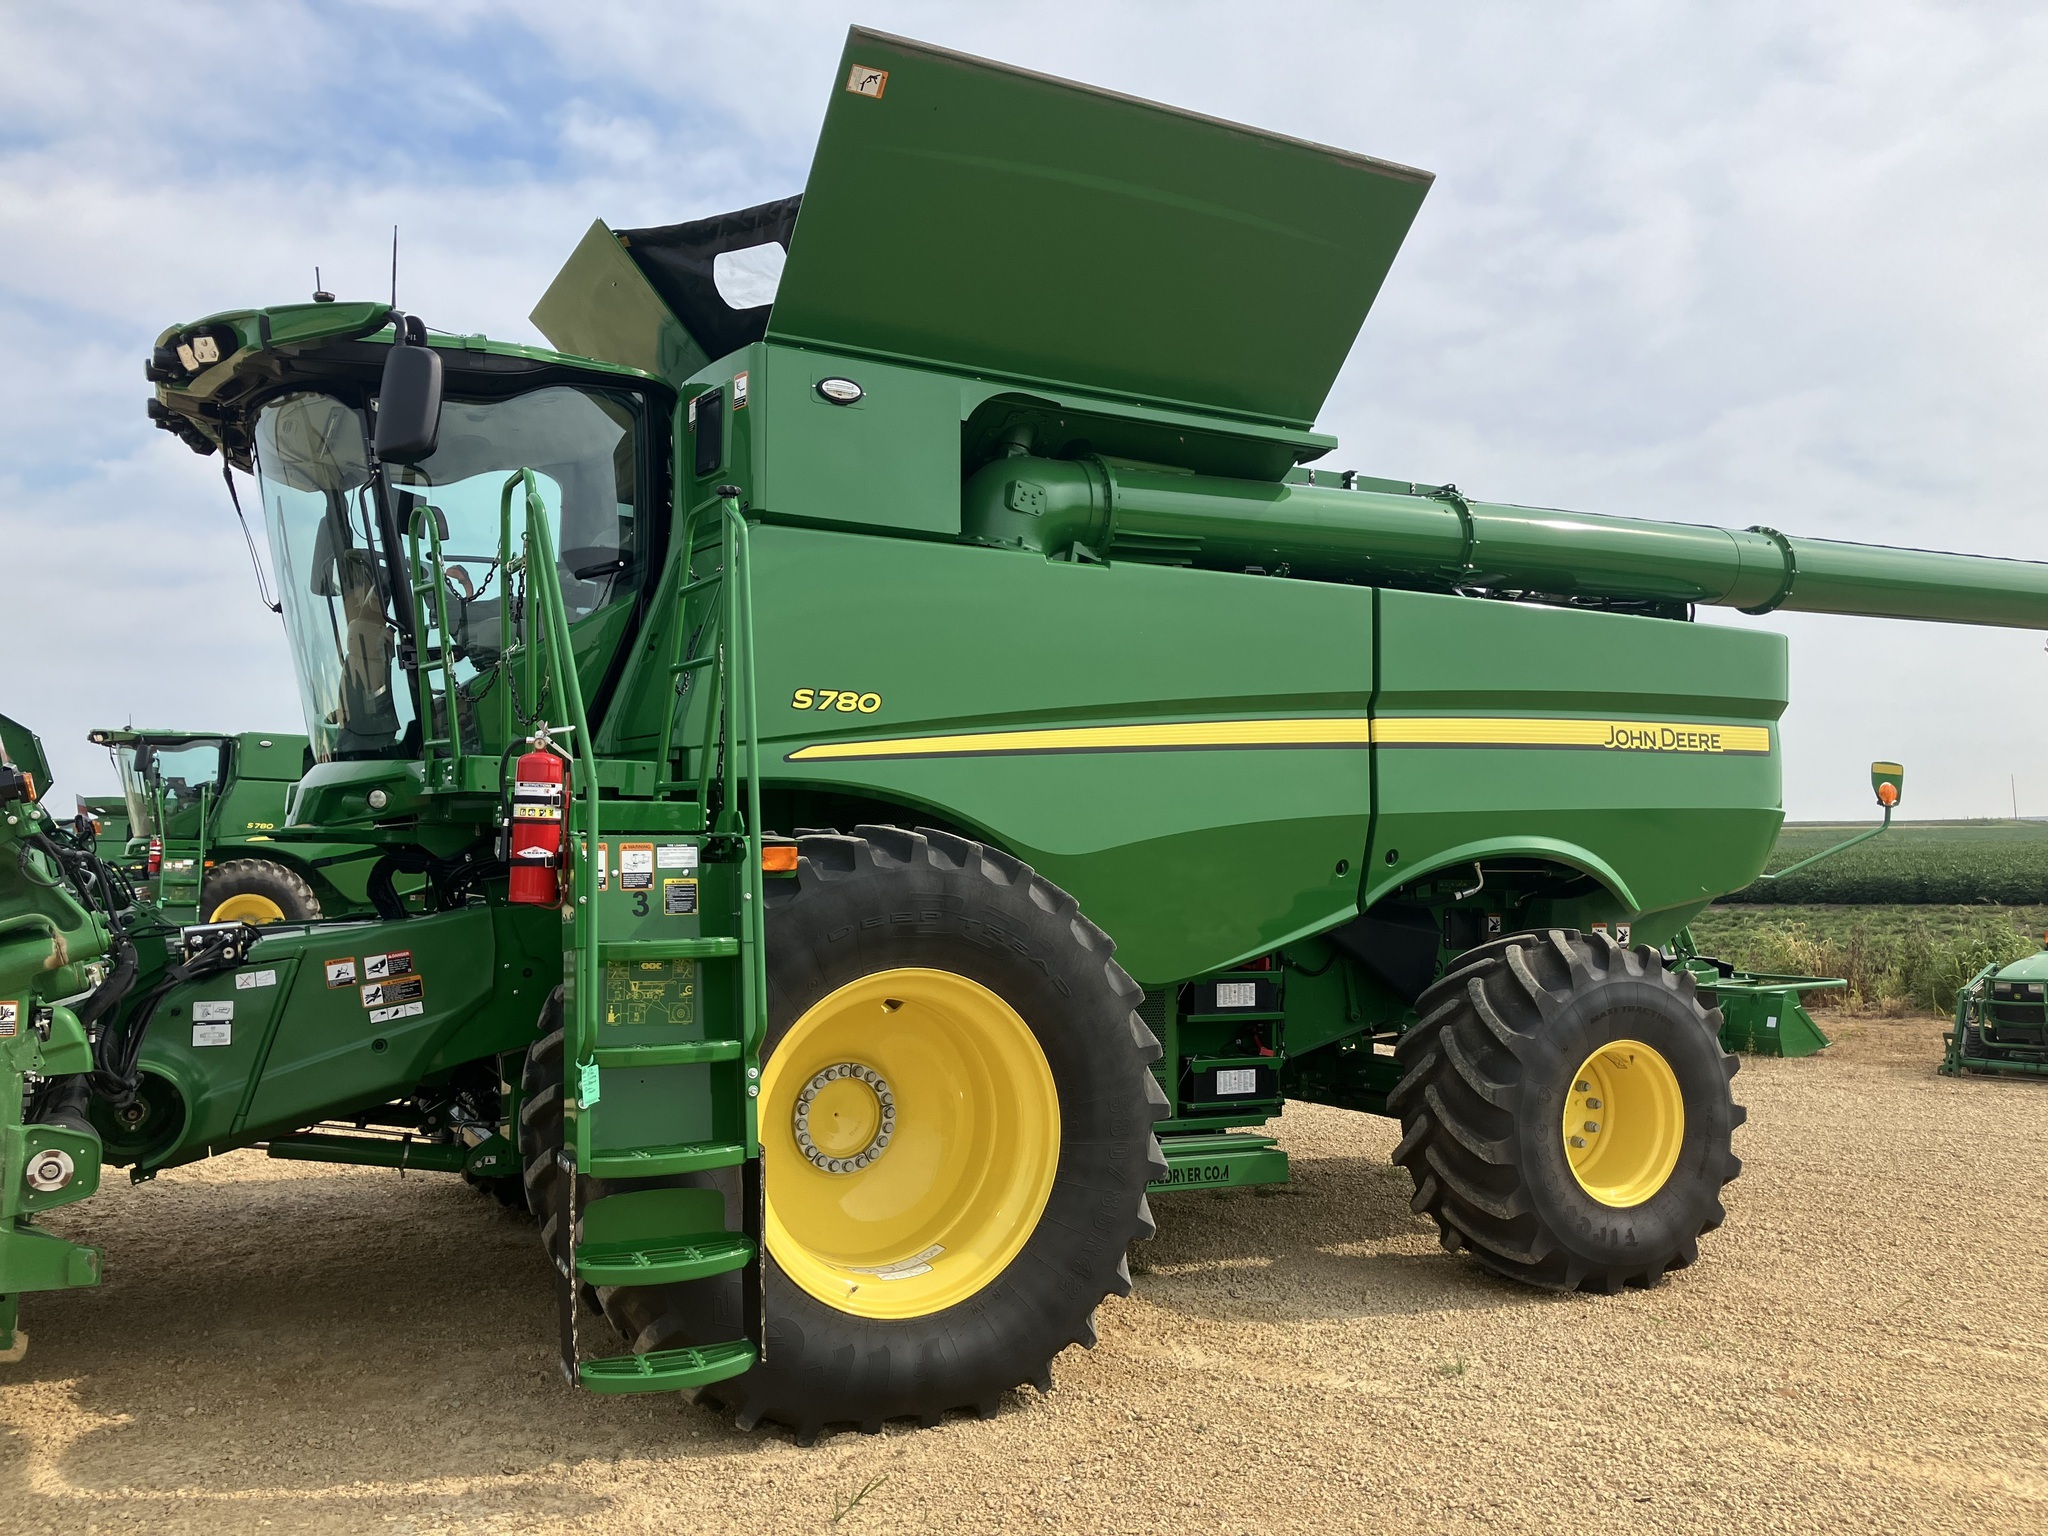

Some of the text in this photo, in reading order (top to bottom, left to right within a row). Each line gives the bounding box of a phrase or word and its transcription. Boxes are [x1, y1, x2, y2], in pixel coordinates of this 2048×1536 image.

[791, 688, 882, 714] S780
[1604, 725, 1722, 749] JOHN DEERE
[246, 822, 274, 830] S780
[632, 891, 650, 917] 3
[827, 911, 1072, 998] DEEP TREAD
